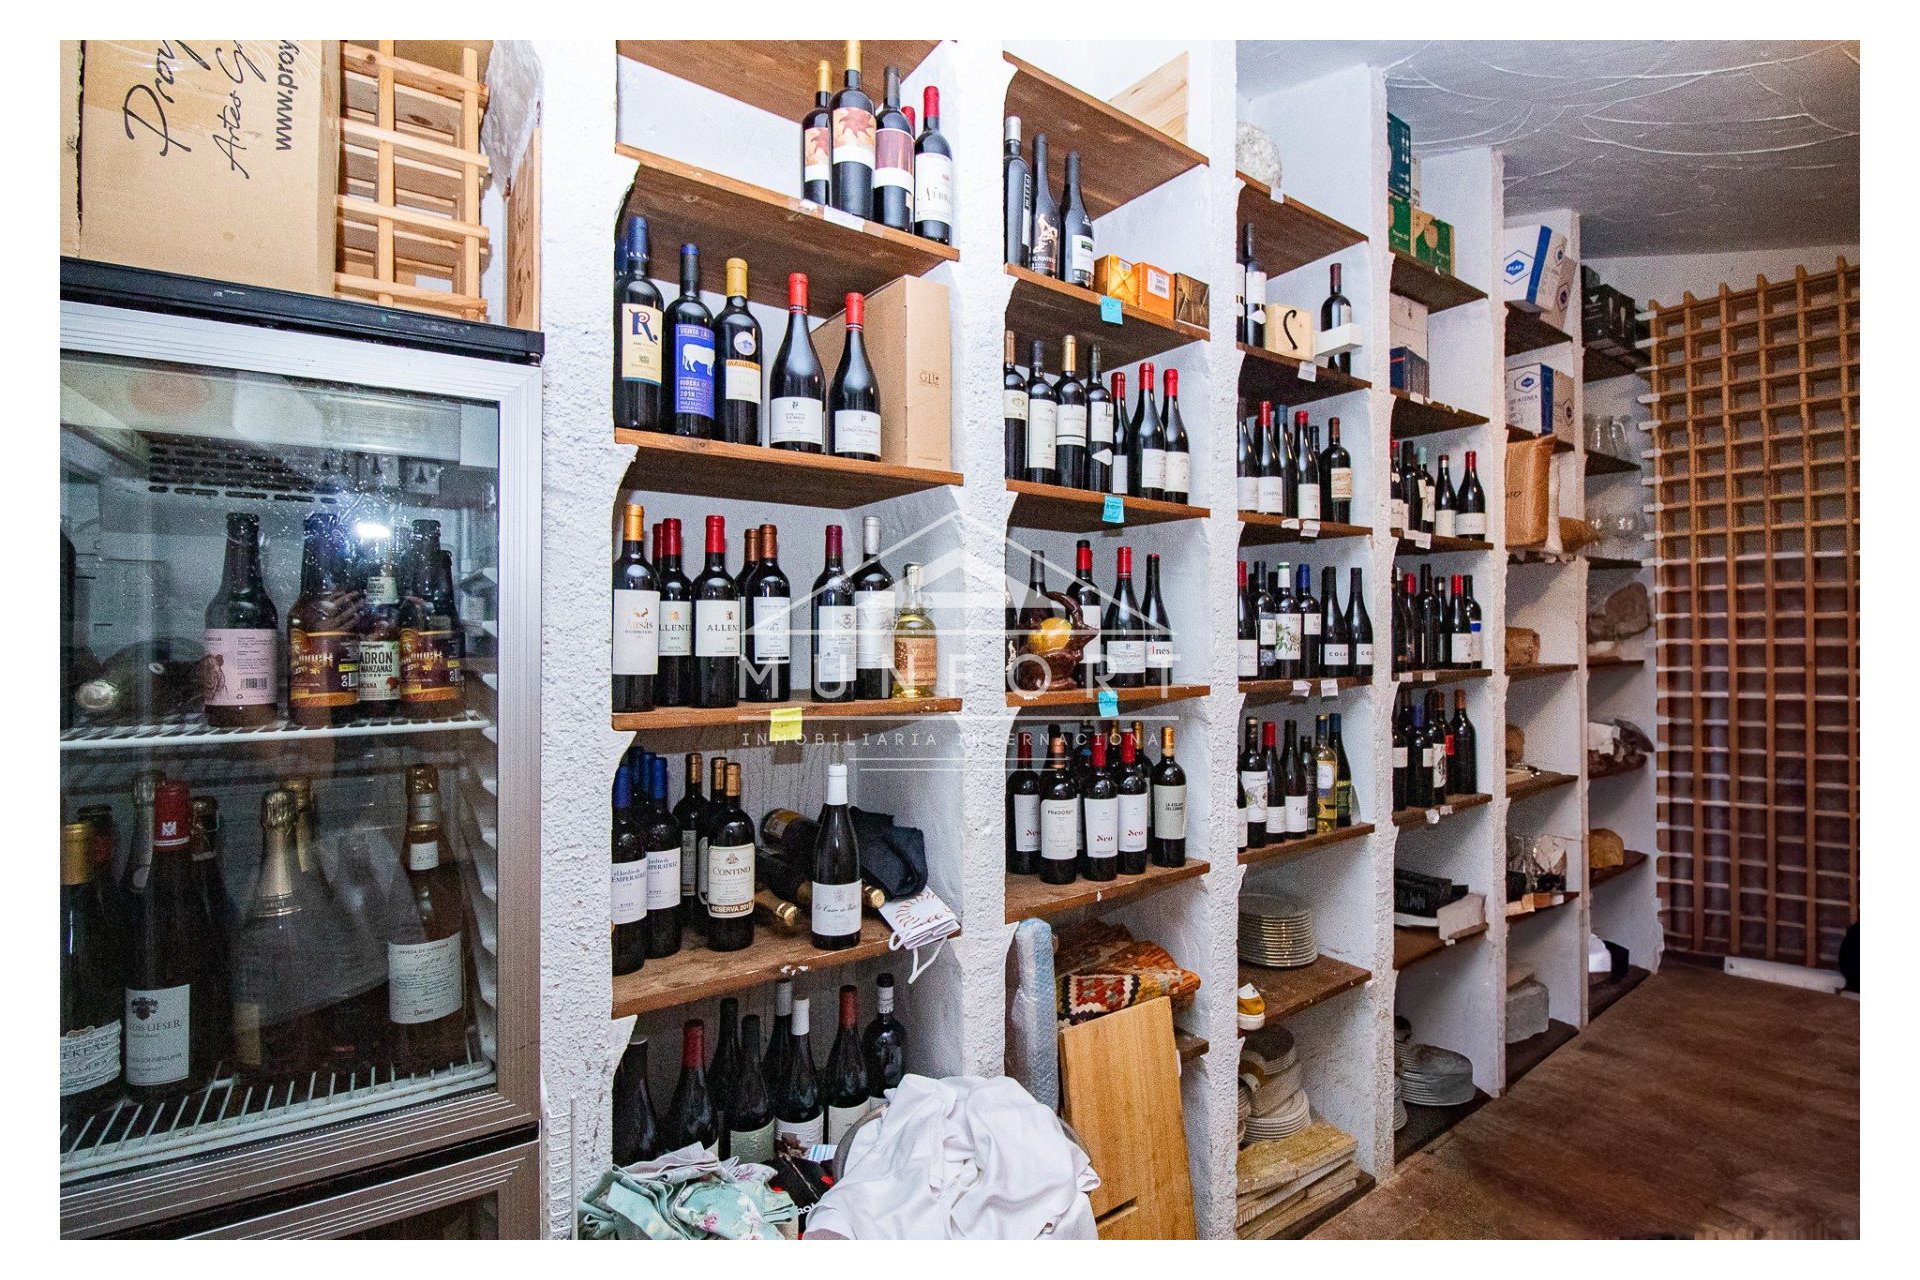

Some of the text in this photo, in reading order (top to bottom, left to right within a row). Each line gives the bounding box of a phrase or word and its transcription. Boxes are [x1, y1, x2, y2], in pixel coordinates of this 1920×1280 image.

[212, 90, 250, 179] Artes
[1096, 834, 1113, 842] Neo
[711, 905, 738, 914] RESERVA
